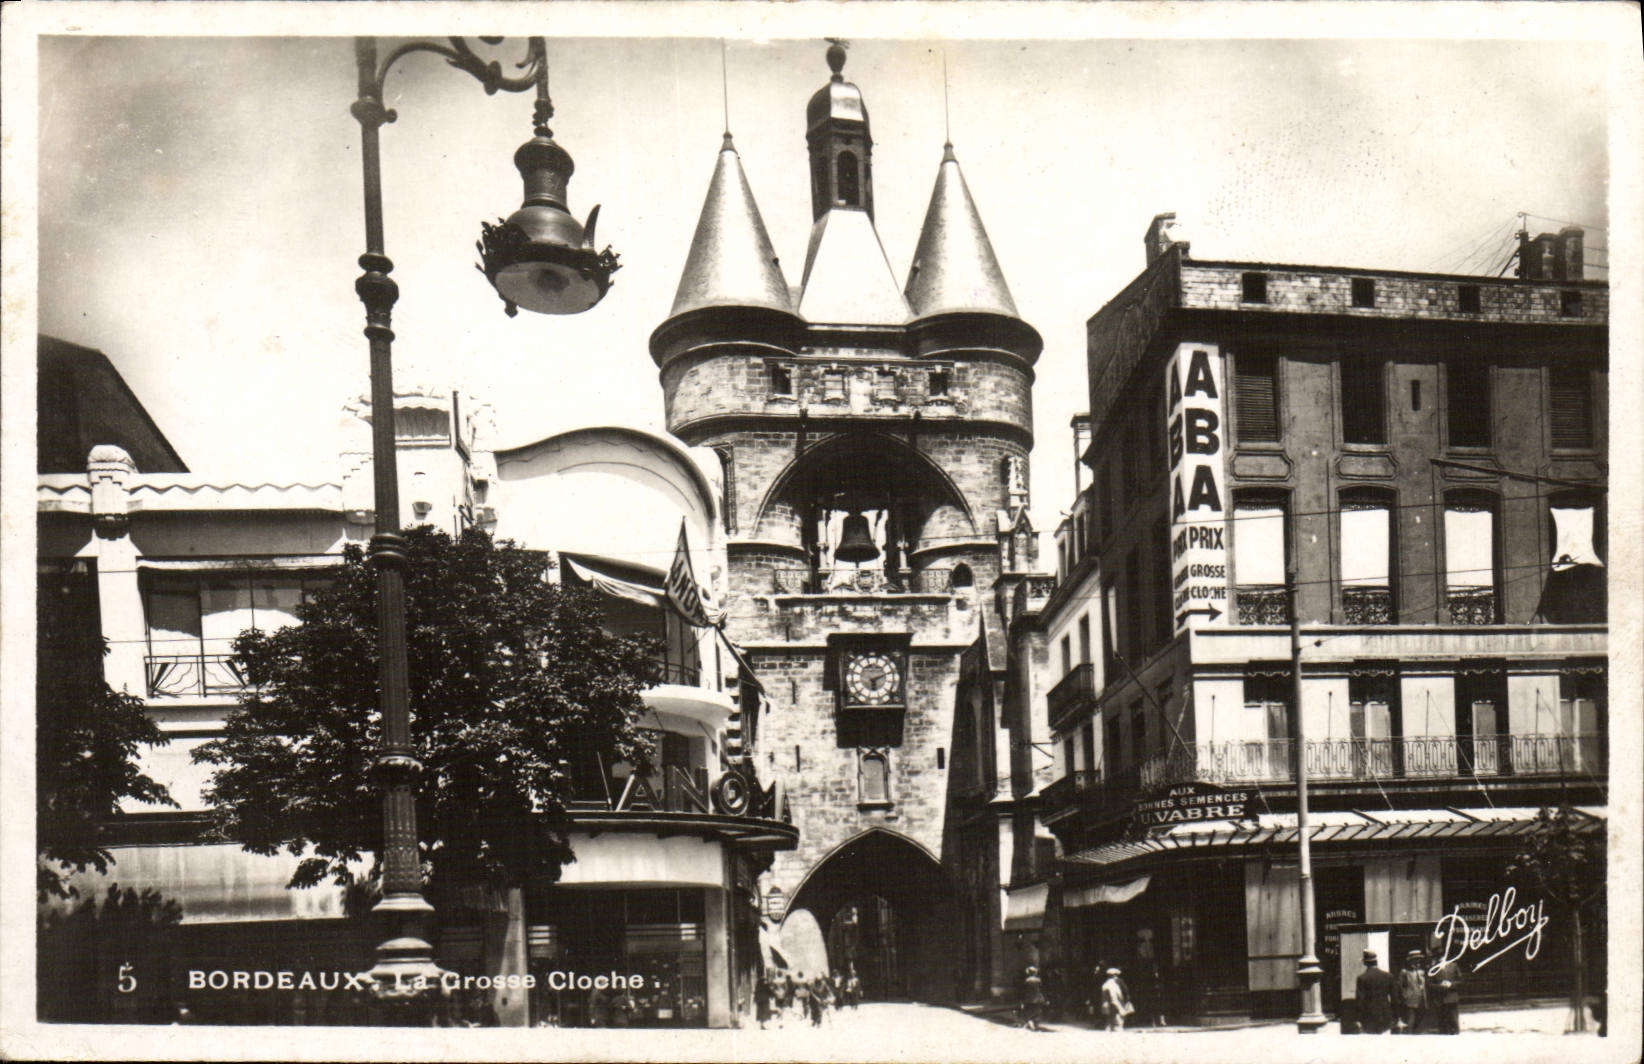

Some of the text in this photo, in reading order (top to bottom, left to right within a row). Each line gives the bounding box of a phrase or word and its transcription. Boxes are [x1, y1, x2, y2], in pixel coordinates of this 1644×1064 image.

[1184, 350, 1222, 512] ABA
[1189, 526, 1224, 550] PRIX
[1190, 564, 1226, 578] GROSSE
[1169, 786, 1196, 797] AUX
[1180, 792, 1248, 807] SEMENCES
